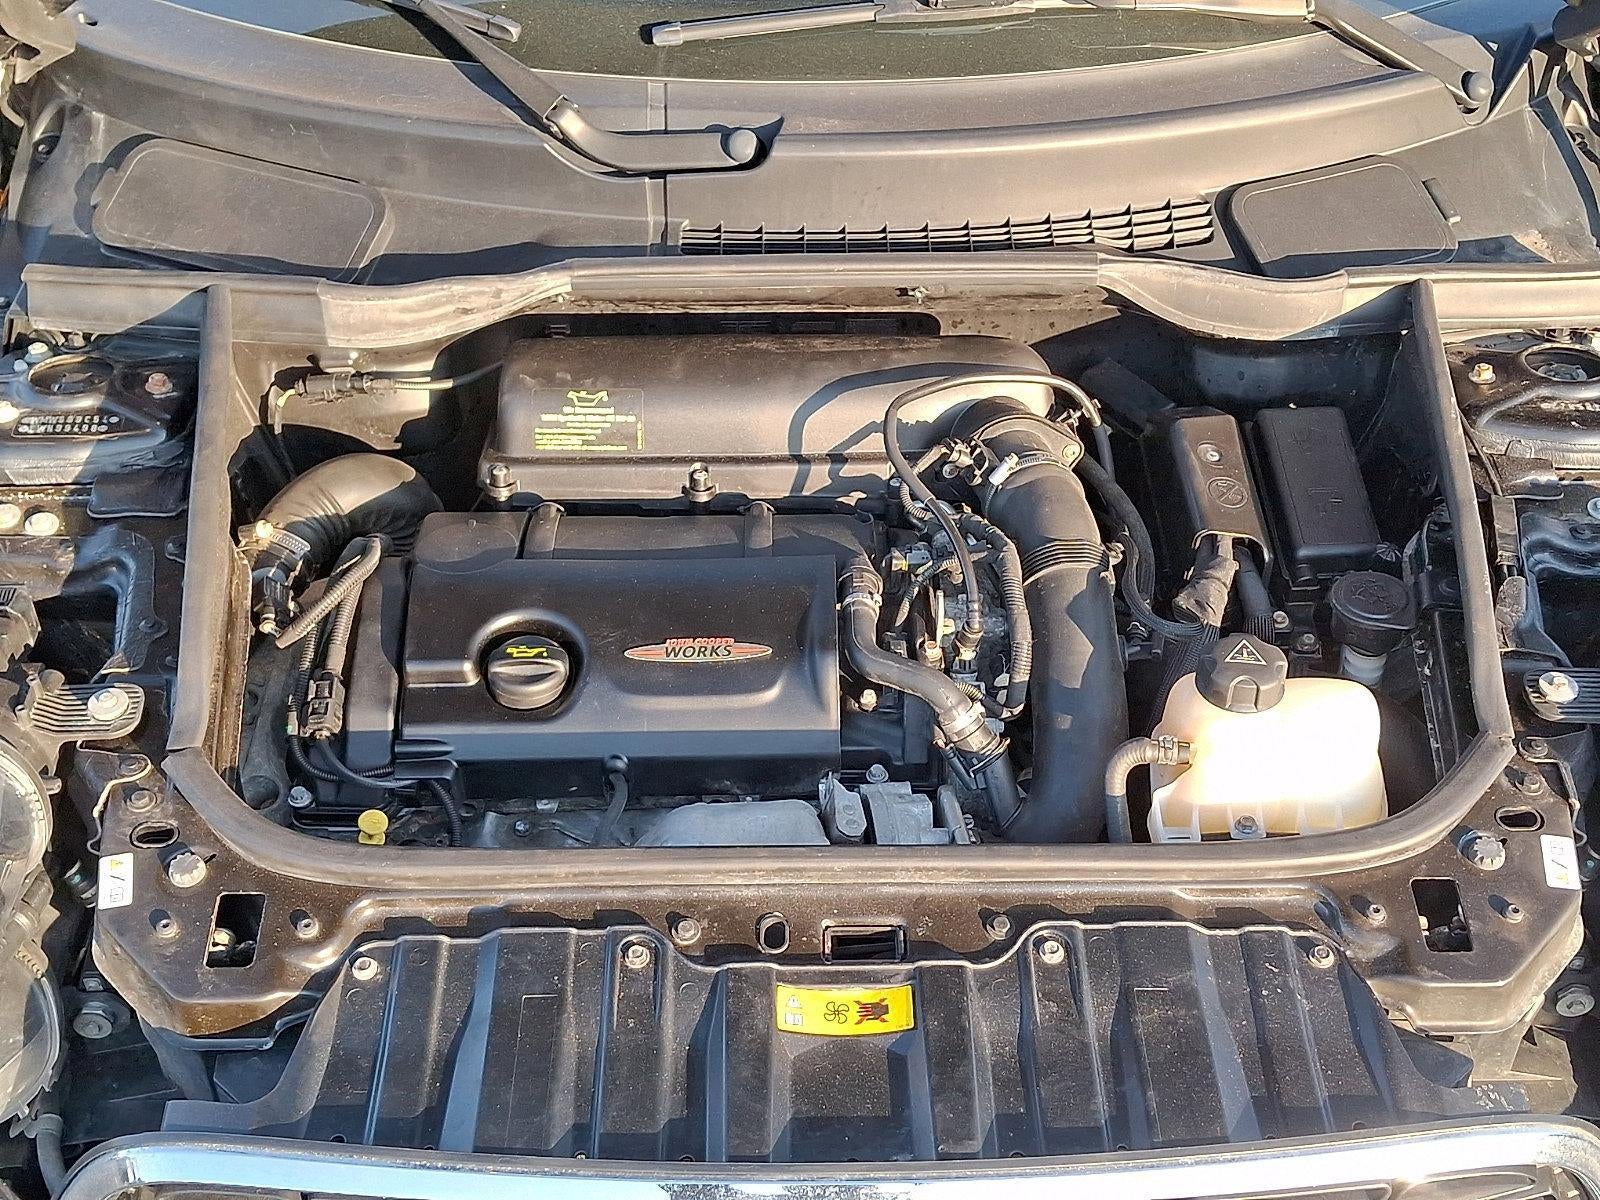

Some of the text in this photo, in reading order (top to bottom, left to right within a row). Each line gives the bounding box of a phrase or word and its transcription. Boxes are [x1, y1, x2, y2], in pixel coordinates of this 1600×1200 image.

[665, 638, 735, 646] JOHN COOPER
[665, 645, 733, 658] WORKS
